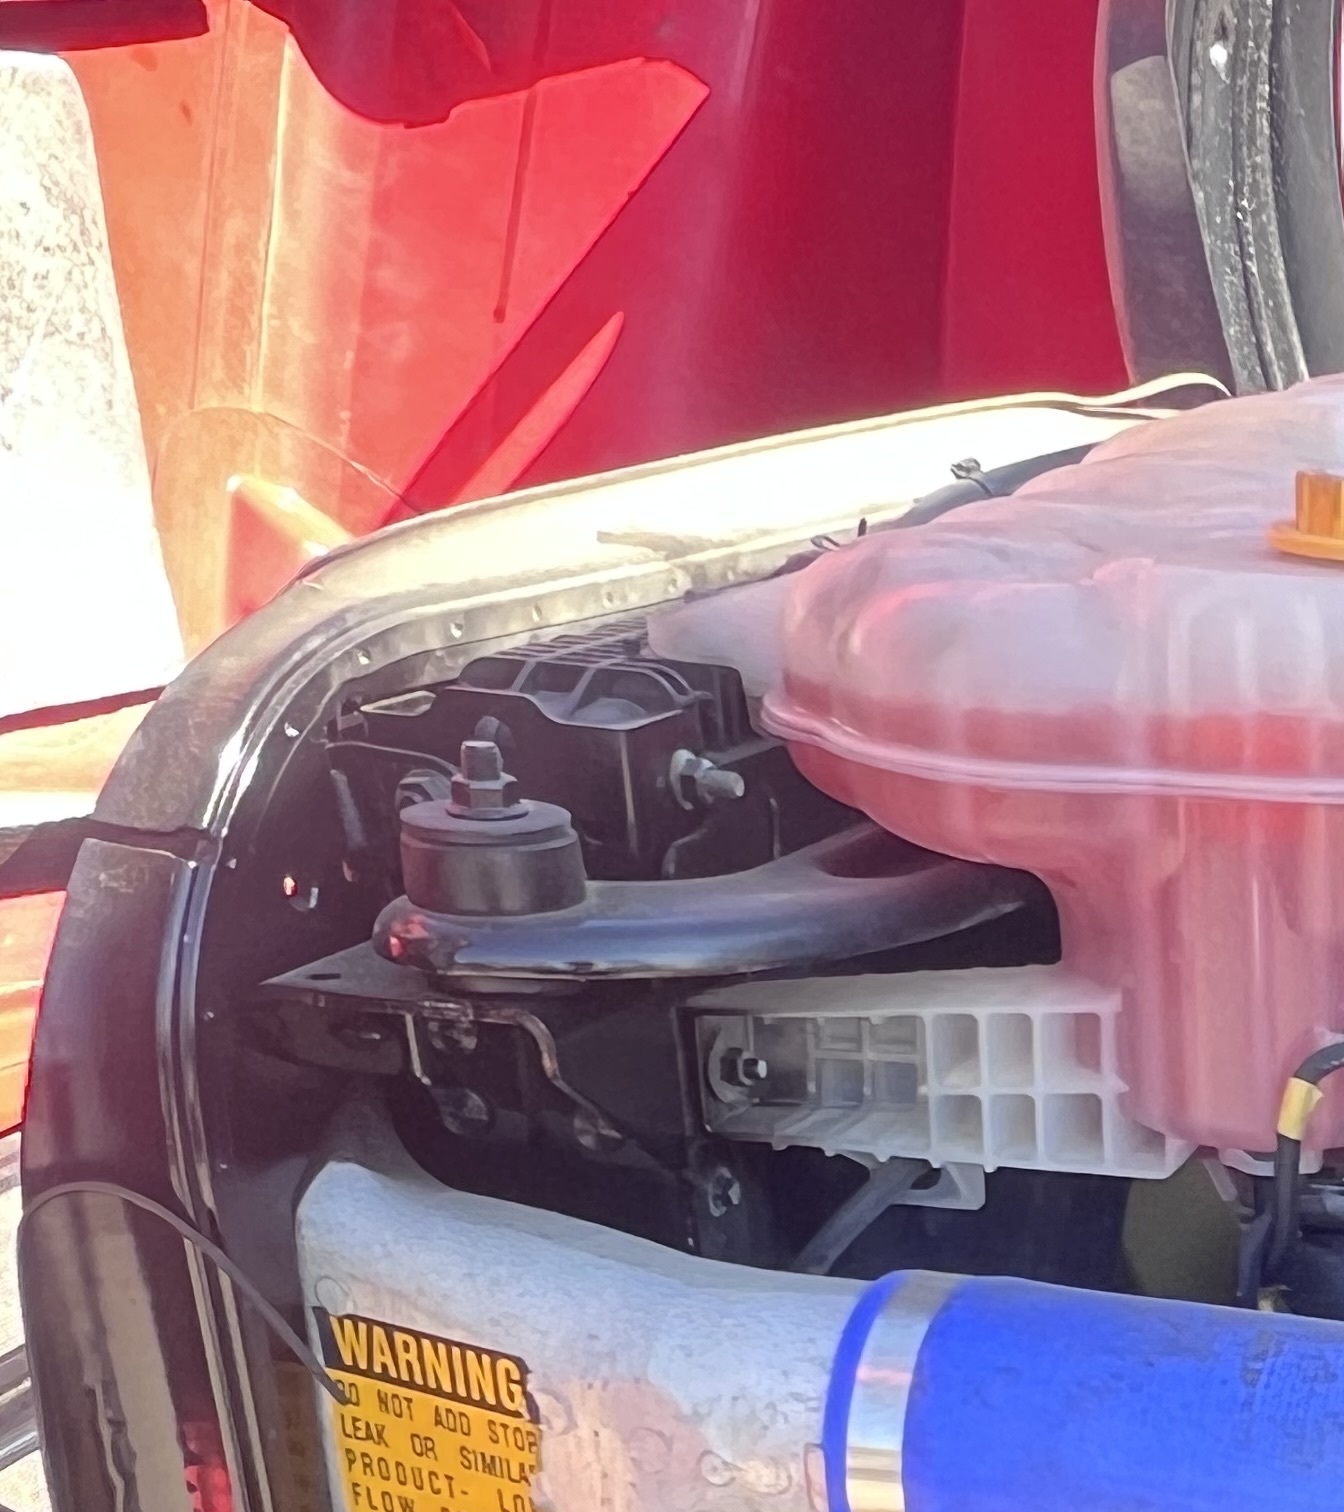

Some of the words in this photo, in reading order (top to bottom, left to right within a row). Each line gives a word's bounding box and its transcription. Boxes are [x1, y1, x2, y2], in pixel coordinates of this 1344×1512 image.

[330, 1316, 526, 1411] WARNING
[377, 1388, 413, 1421] NOT
[434, 1404, 471, 1437] ADD
[341, 1413, 390, 1449] LEAK
[410, 1433, 439, 1462] OR
